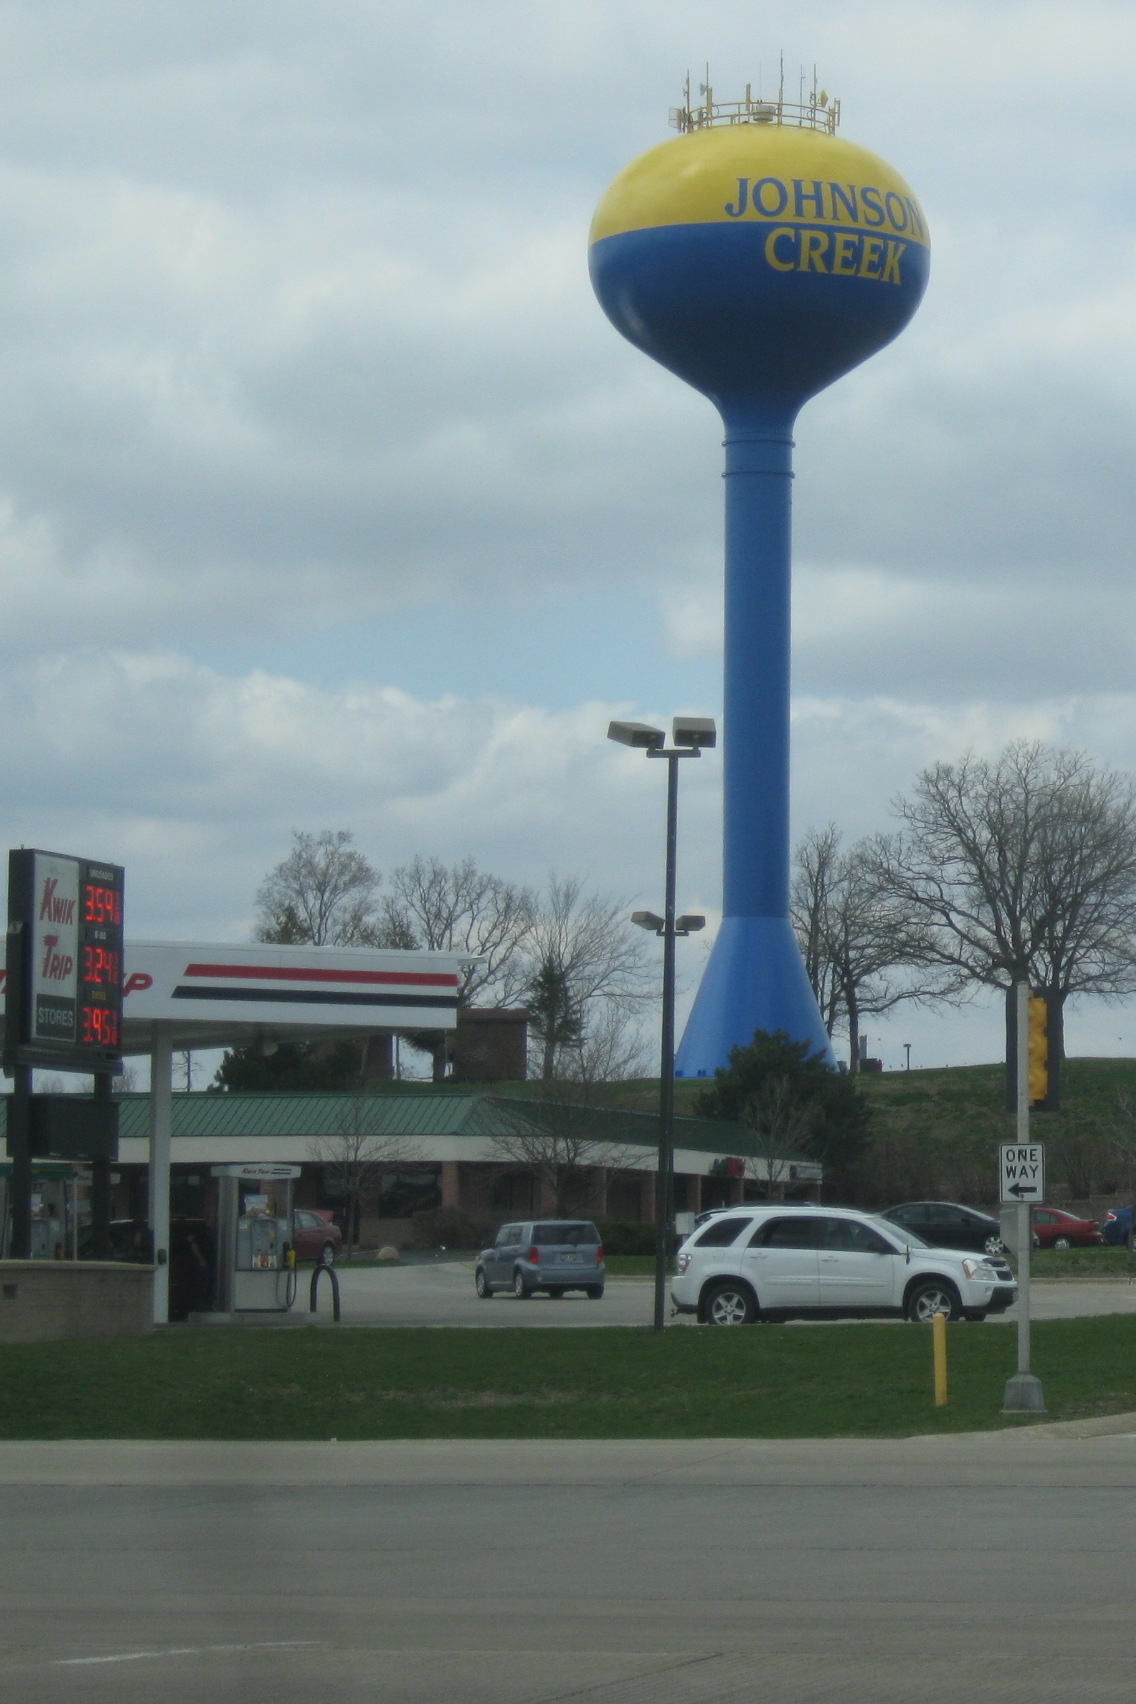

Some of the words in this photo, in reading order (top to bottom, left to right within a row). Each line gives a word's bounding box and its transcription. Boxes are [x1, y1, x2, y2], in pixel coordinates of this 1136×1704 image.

[725, 177, 923, 239] JOHNSON
[764, 227, 908, 285] CREEK
[42, 934, 73, 981] TRIP
[38, 1007, 74, 1027] STORES
[1006, 1148, 1038, 1162] ONE
[1006, 1165, 1039, 1179] WAY
